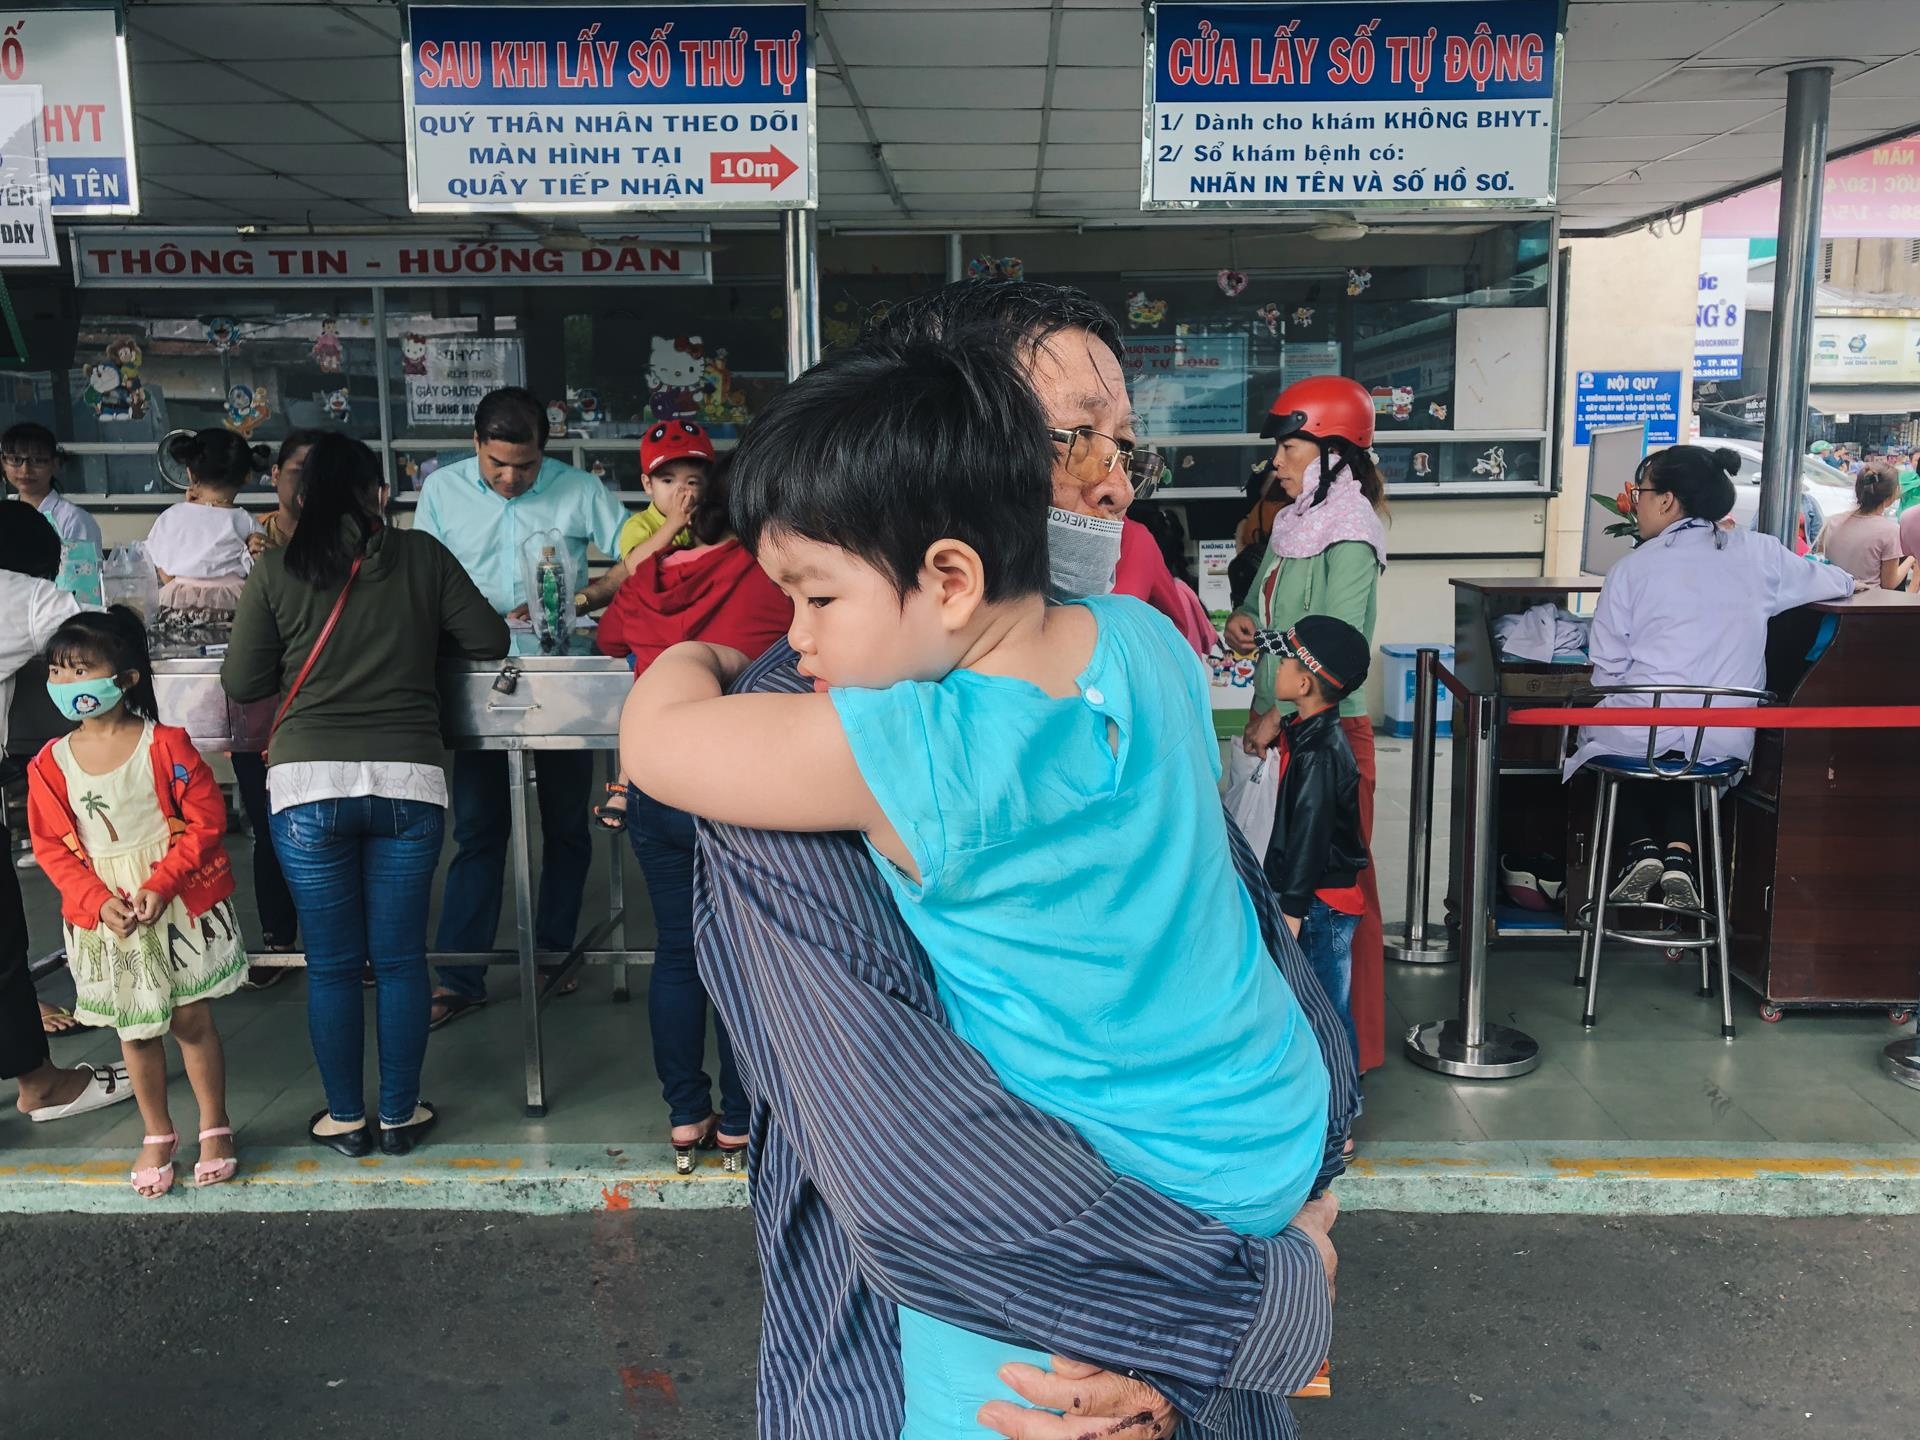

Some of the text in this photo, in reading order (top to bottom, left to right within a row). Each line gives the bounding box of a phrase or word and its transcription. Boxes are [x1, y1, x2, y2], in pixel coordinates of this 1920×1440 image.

[0, 20, 25, 80] Ố
[418, 22, 801, 96] SAU KHI LẤY SỐ THỨ TỰ
[1168, 18, 1543, 93] CỬA LẤY SỐ TỰ ĐỘNG
[419, 109, 799, 136] QUÝ THÂN NHÂN THEO DÕI
[1160, 106, 1549, 131] 1/ Dành cho khám KHÔNG BHYT.
[469, 143, 681, 167] MÀN HÌNH TẠI
[1158, 141, 1404, 165] 2/ Sổ khám bệnh có:
[720, 158, 780, 179] 10m
[1190, 166, 1515, 194] NHÃN IN TÊN VÀ SỐ HỒ SƠ.
[71, 168, 119, 198] TÊN
[447, 171, 704, 199] QUẦY TIẾP NHẬN
[1, 219, 35, 244] ĐÂY
[88, 236, 681, 275] THÔNG TIN - HƯỚNG DẪN
[1725, 304, 1737, 327] 8
[1607, 375, 1658, 392] NỘI QUY
[1297, 646, 1322, 673] GUCCI
